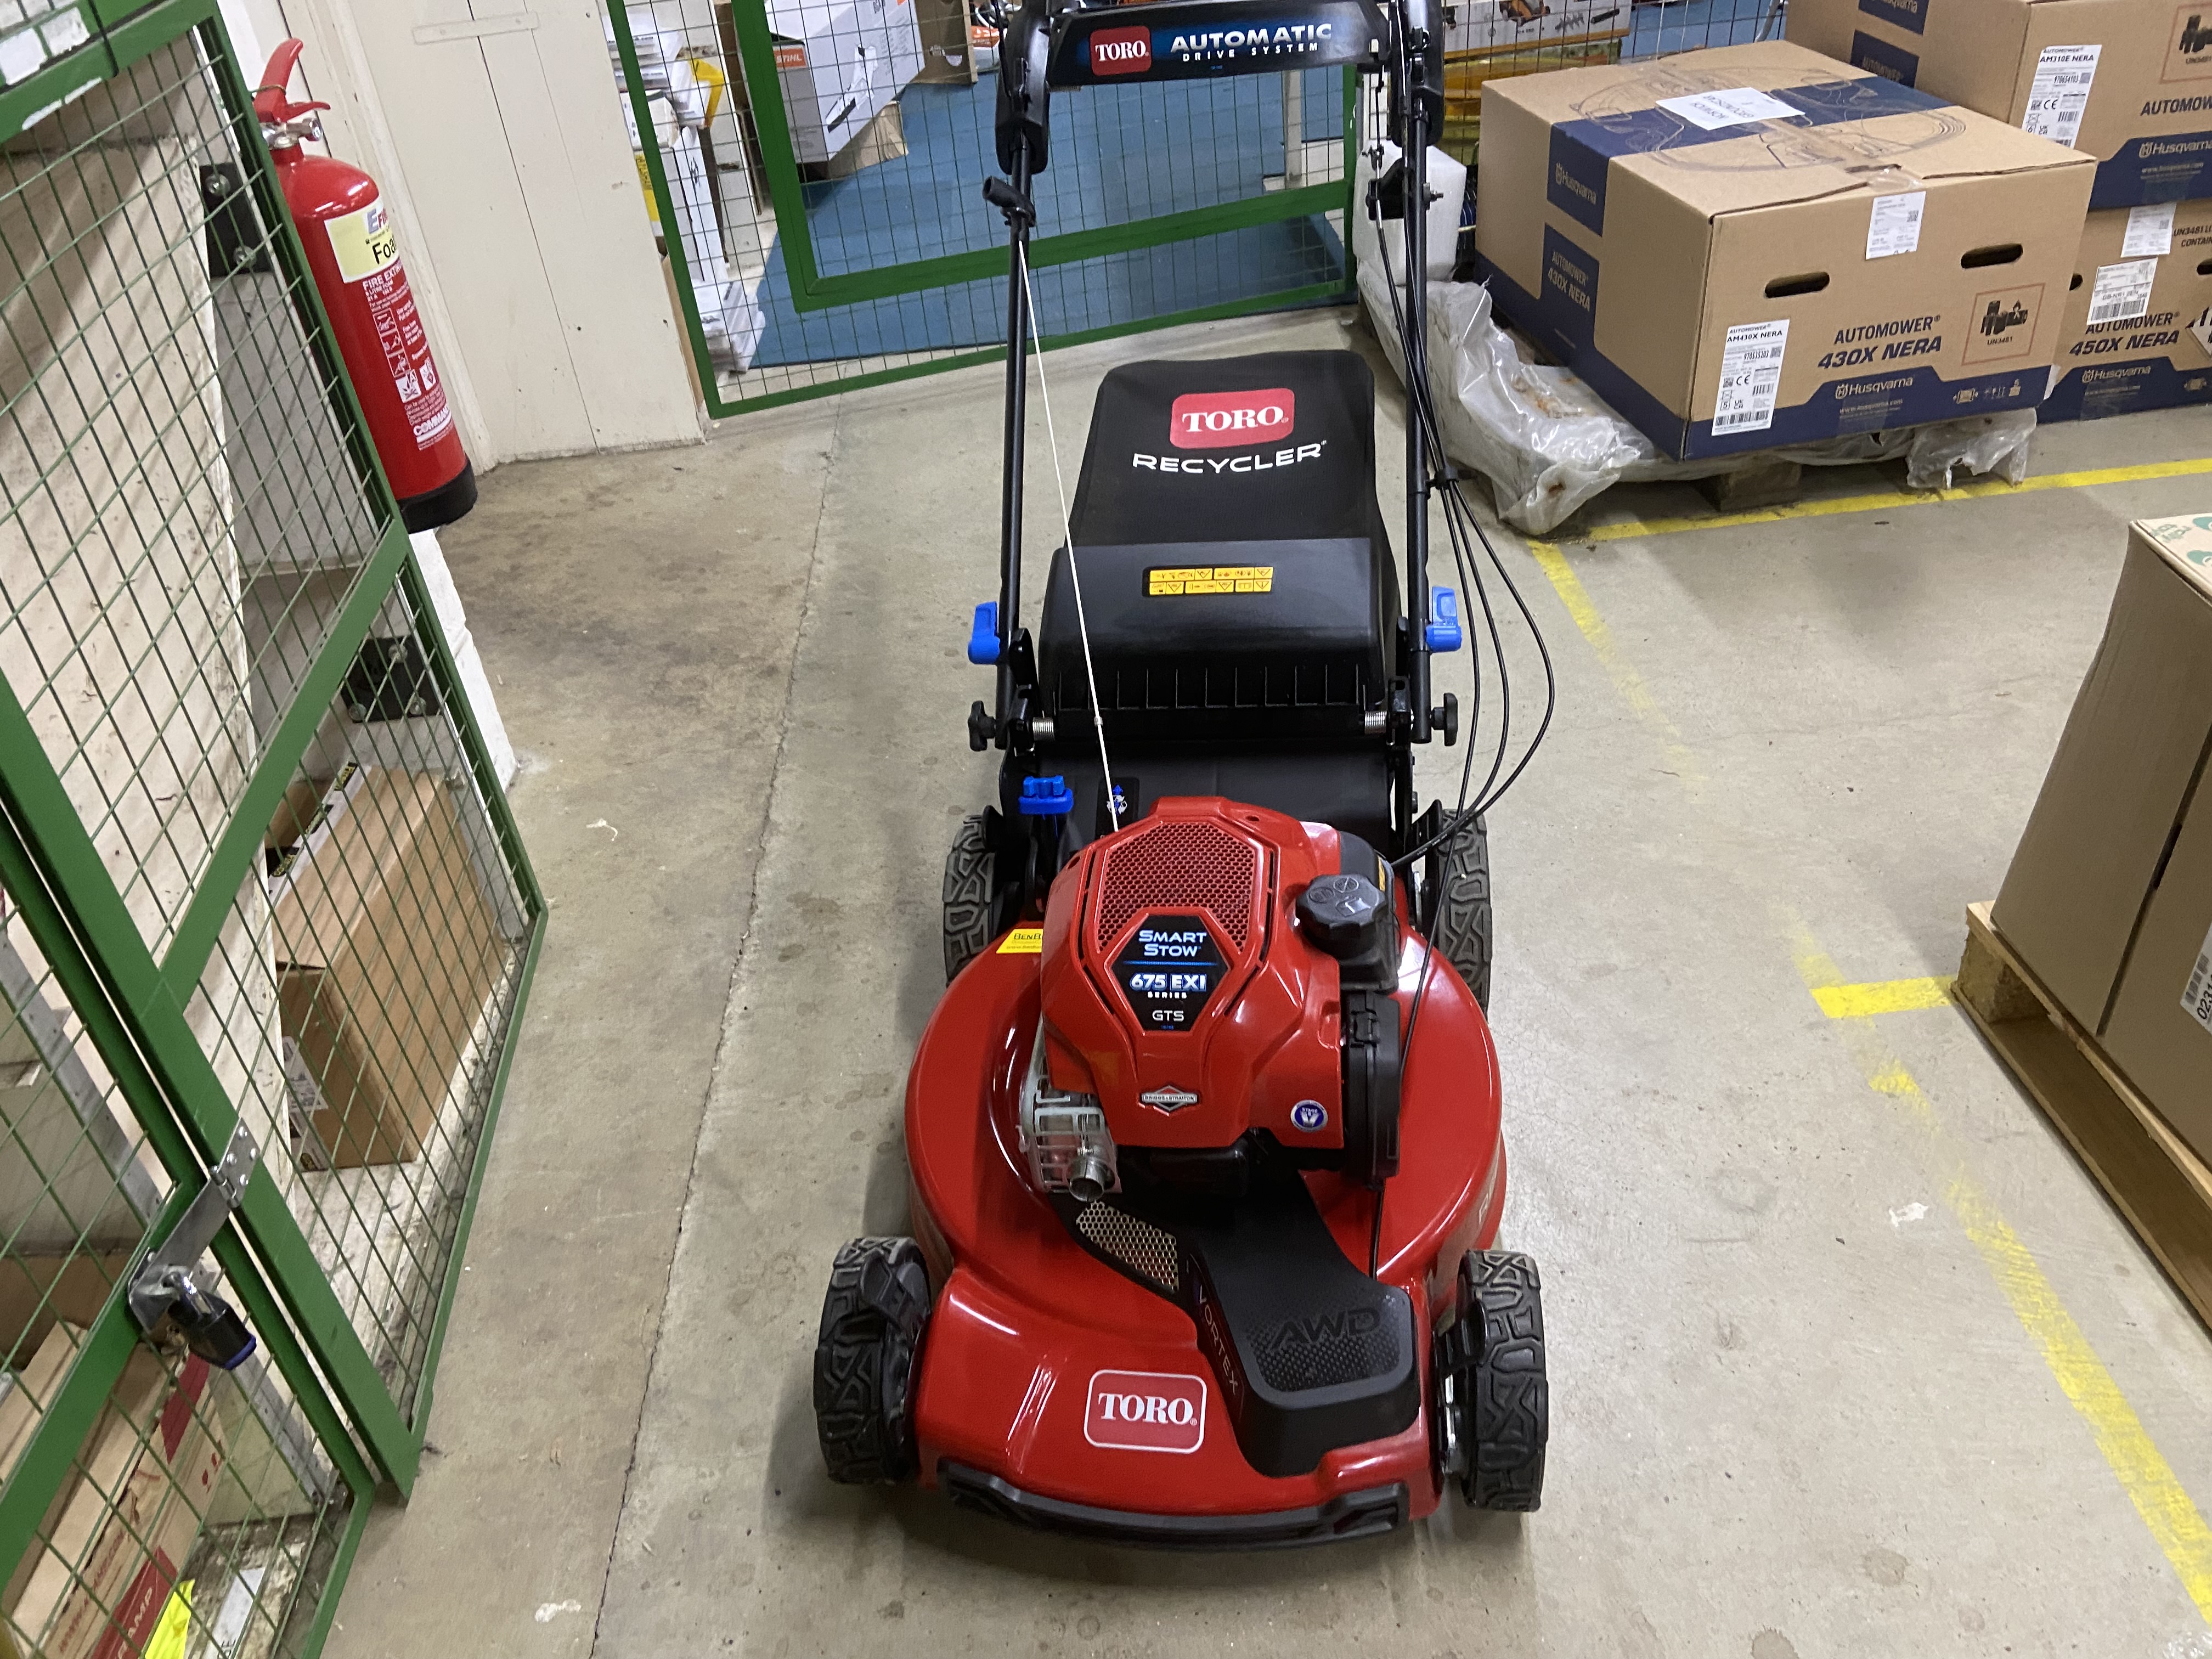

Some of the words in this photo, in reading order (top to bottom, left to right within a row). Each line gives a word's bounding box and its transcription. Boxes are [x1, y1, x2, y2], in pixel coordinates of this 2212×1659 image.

[1095, 40, 1146, 61] TORO
[1170, 24, 1331, 53] AUTOMATIC
[1183, 49, 1234, 61] DRIVE
[1251, 43, 1318, 55] SYSTEM
[373, 234, 397, 264] Foa
[1552, 251, 1587, 287] AUTOMOWER
[1548, 267, 1567, 294] 430X
[1568, 281, 1590, 312] NERA
[1760, 330, 1782, 338] NERA
[1834, 315, 1933, 345] AUTOMOWER
[2069, 336, 2124, 356] 450X
[2125, 330, 2180, 350] NERA
[1818, 346, 1878, 369] 430X
[1882, 336, 1942, 360] NERA
[1848, 376, 1914, 396] Husqvarna
[2094, 366, 2151, 380] Husqvarna
[1182, 407, 1284, 432] TORO
[1132, 443, 1322, 474] RECYCLER
[1130, 973, 1167, 991] 675
[1170, 973, 1207, 992] EXI
[1152, 1010, 1184, 1022] GTS
[1199, 1285, 1239, 1396] VORTEX
[1270, 1308, 1380, 1352] AWD
[1098, 1392, 1194, 1425] TORO
